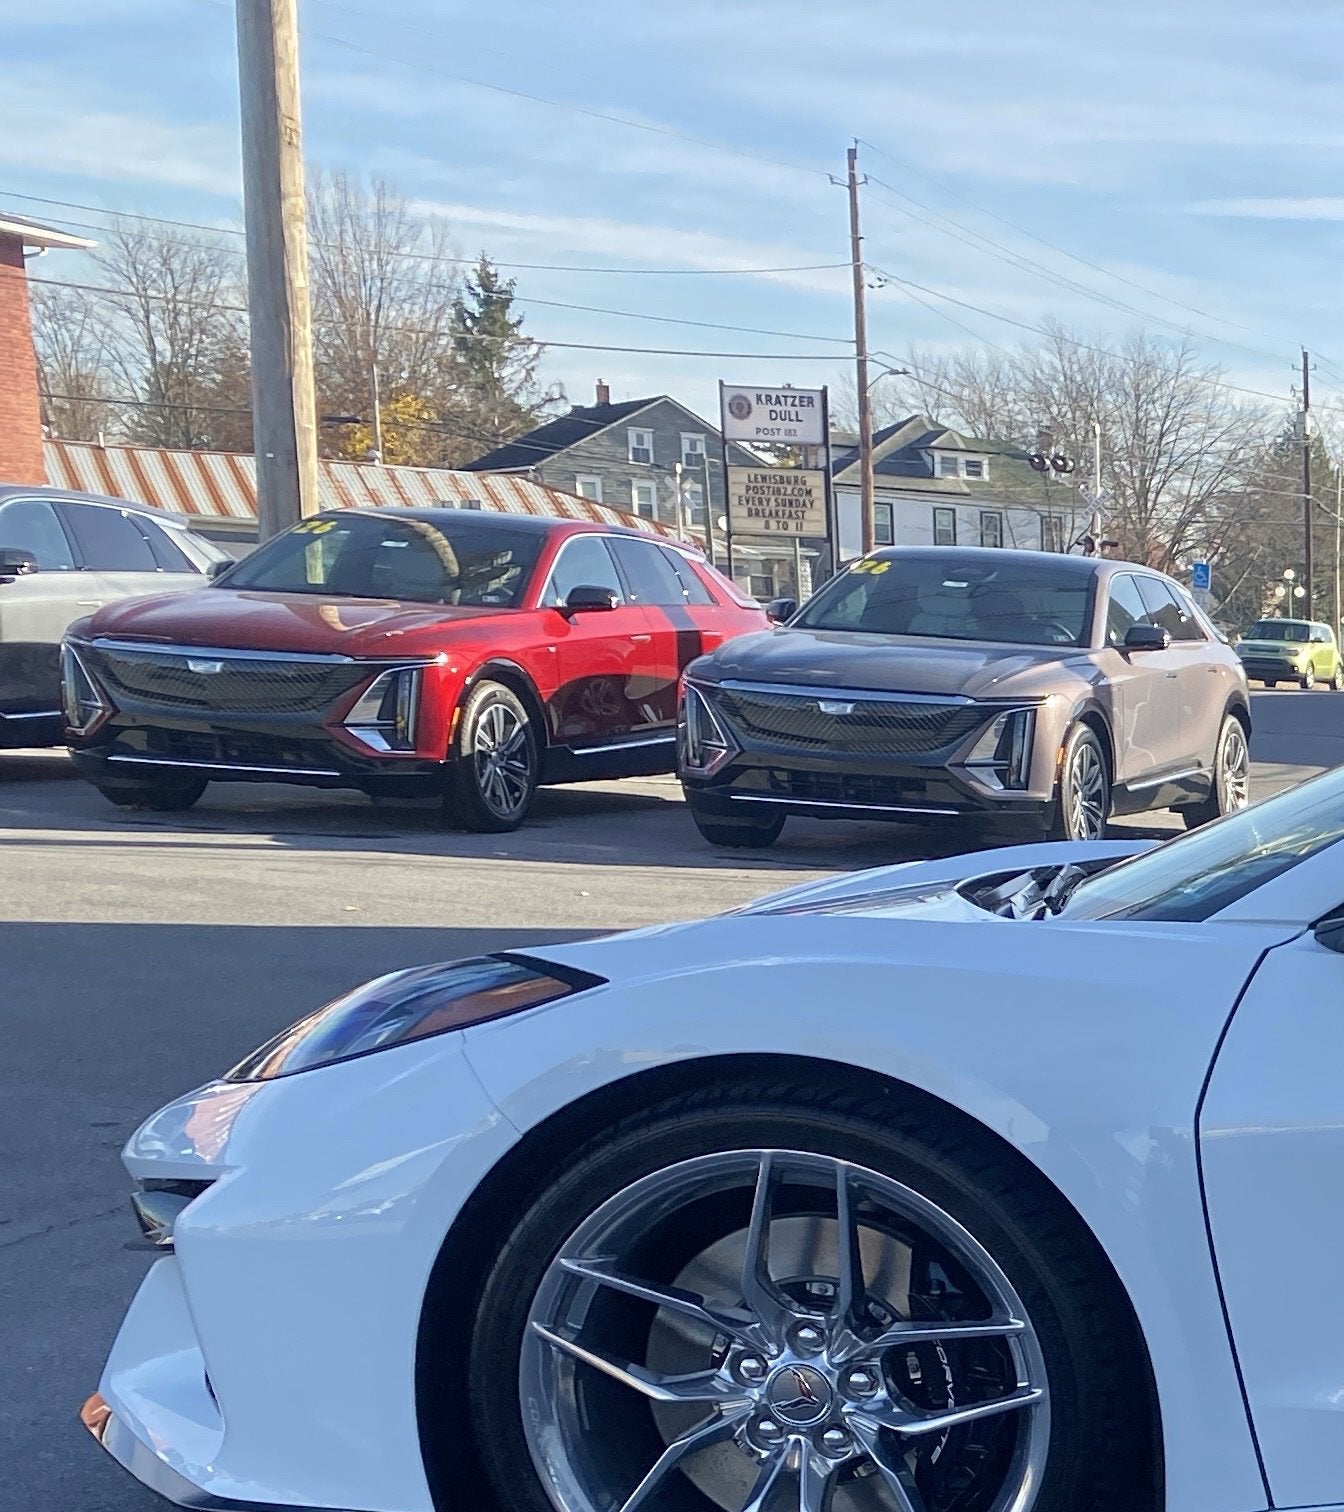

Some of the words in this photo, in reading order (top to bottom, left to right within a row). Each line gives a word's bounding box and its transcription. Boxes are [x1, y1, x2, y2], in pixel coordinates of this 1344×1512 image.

[756, 393, 814, 408] KRATZER
[769, 409, 803, 422] DULL
[755, 427, 781, 436] POST
[747, 473, 807, 486] LEWISBURG
[737, 495, 771, 506] EVERY
[774, 497, 814, 509] SUNDAY
[747, 507, 806, 520] BREAKFAST
[776, 520, 789, 530] TO
